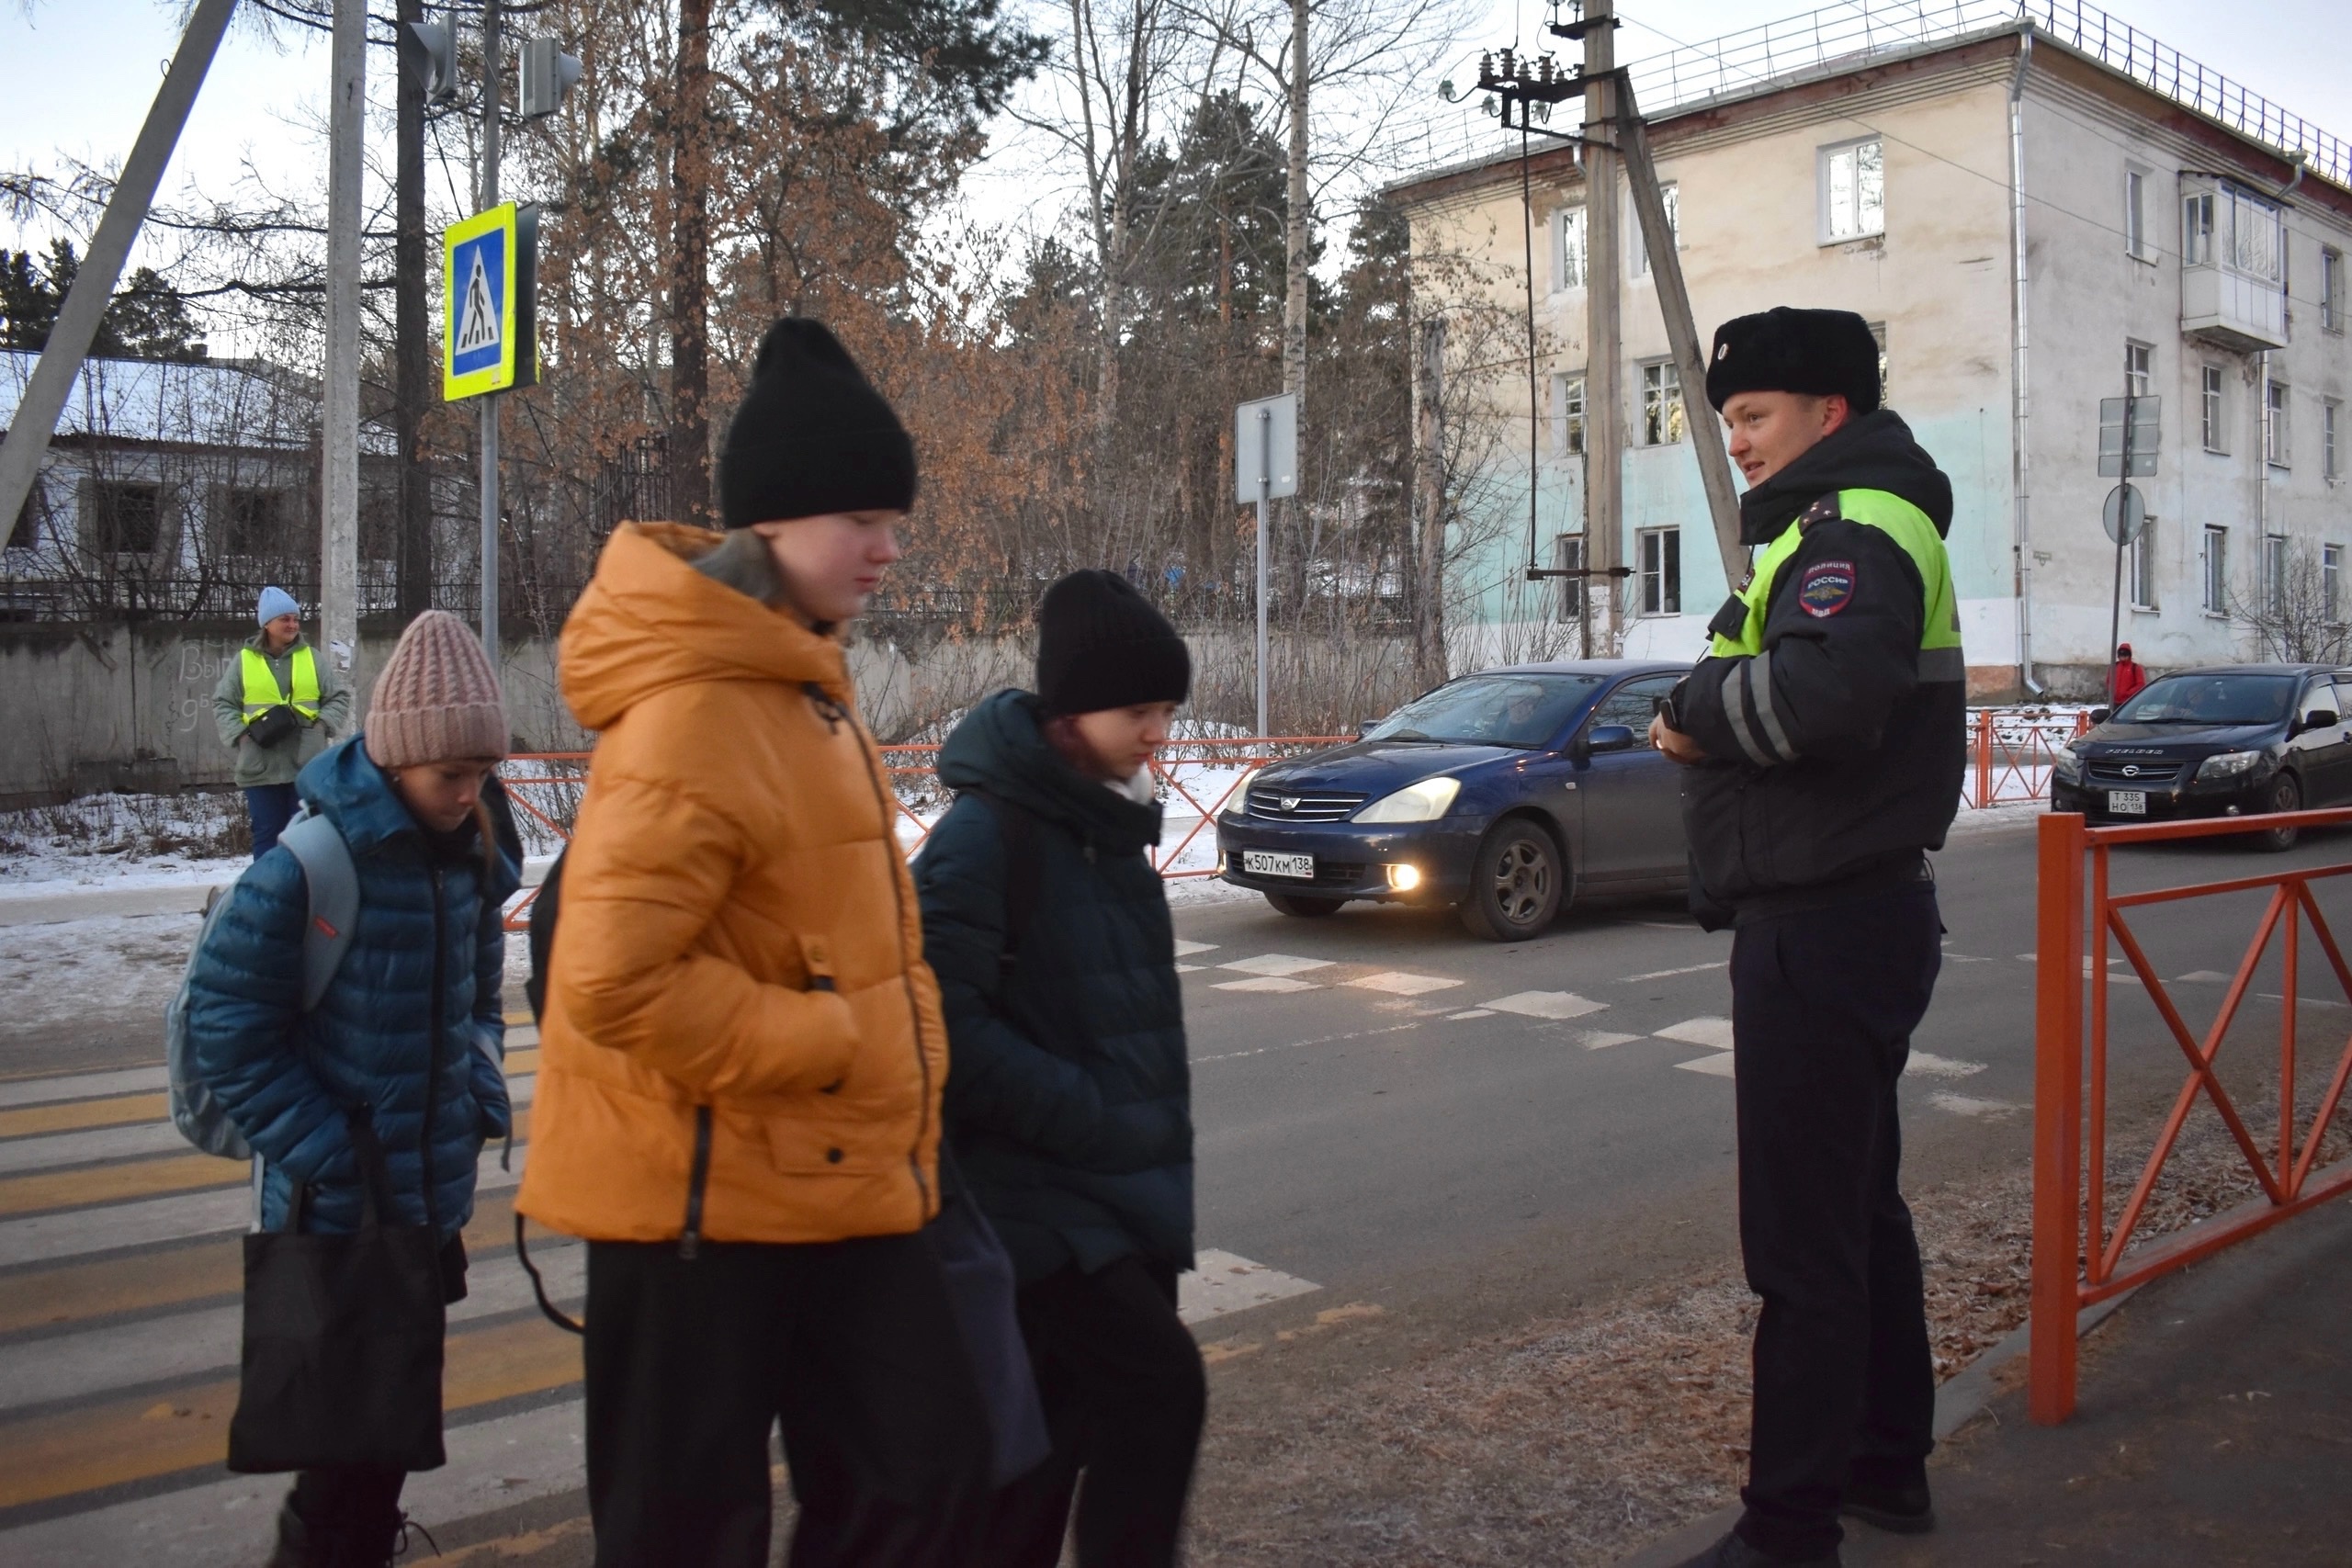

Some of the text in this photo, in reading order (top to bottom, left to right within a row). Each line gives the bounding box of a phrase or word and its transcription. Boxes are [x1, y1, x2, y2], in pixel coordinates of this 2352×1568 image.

[1808, 561, 1850, 574] ПОЛИЦИЯ
[1807, 576, 1849, 590] РОССИЯ
[2123, 792, 2141, 802] 335
[2111, 802, 2127, 812] НО
[1247, 854, 1310, 874] К507КМ 138
